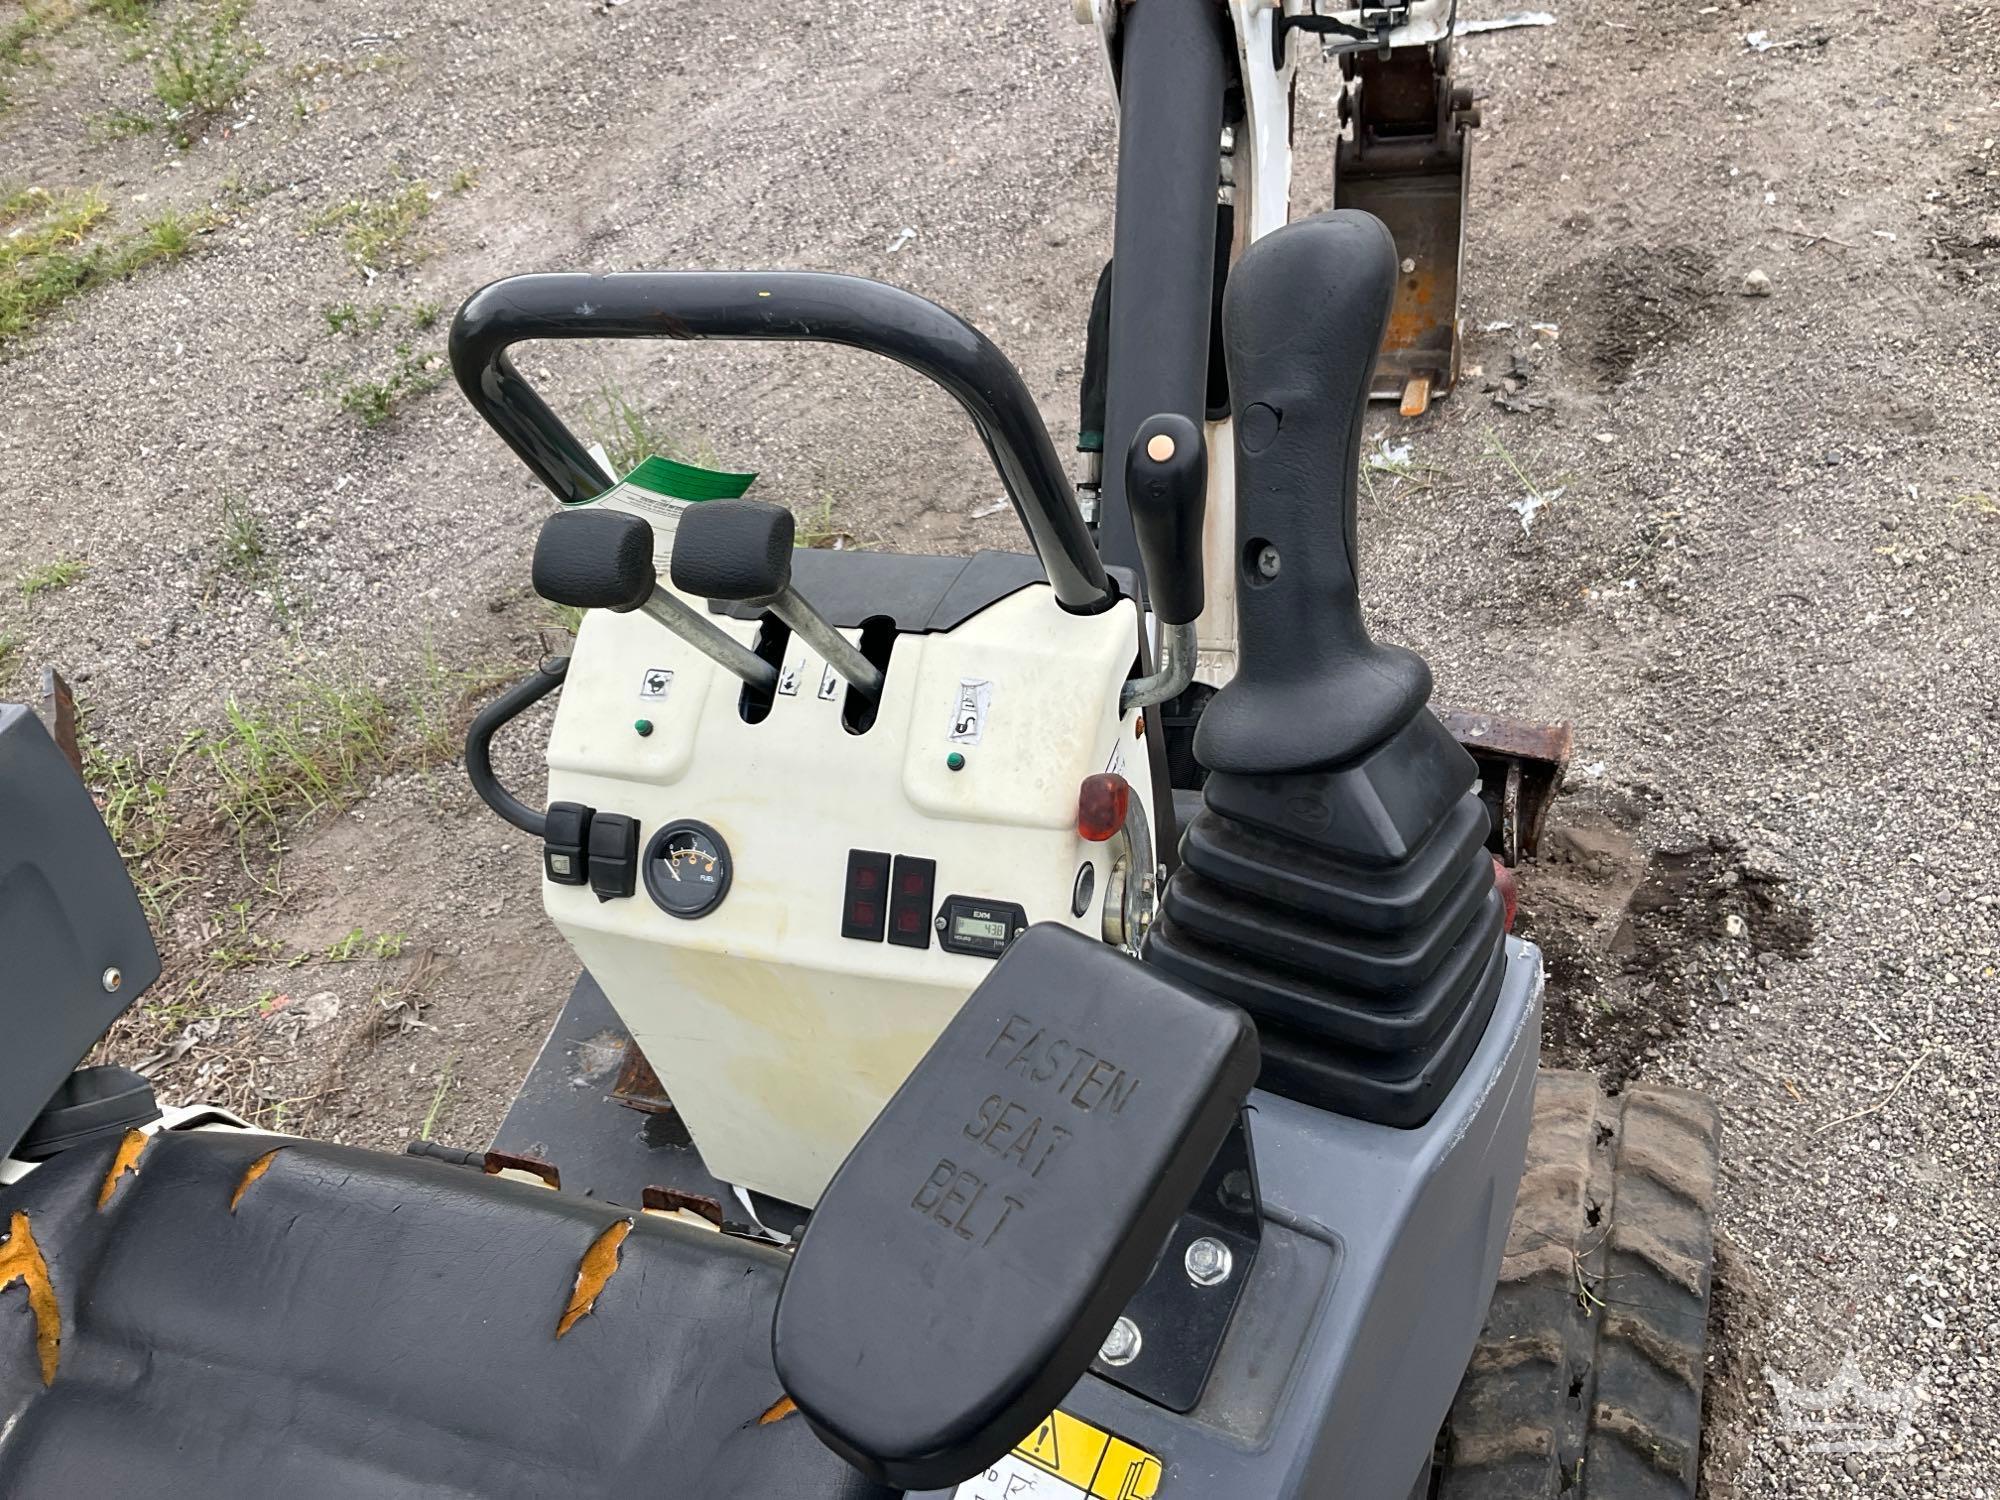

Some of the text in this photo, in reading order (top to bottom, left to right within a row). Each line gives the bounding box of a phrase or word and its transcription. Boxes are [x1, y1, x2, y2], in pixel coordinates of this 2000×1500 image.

[700, 874, 715, 882] FUEL
[985, 1014, 1140, 1115] FASTEN
[962, 1094, 1073, 1178] SEAT
[910, 1157, 1025, 1248] BELT
